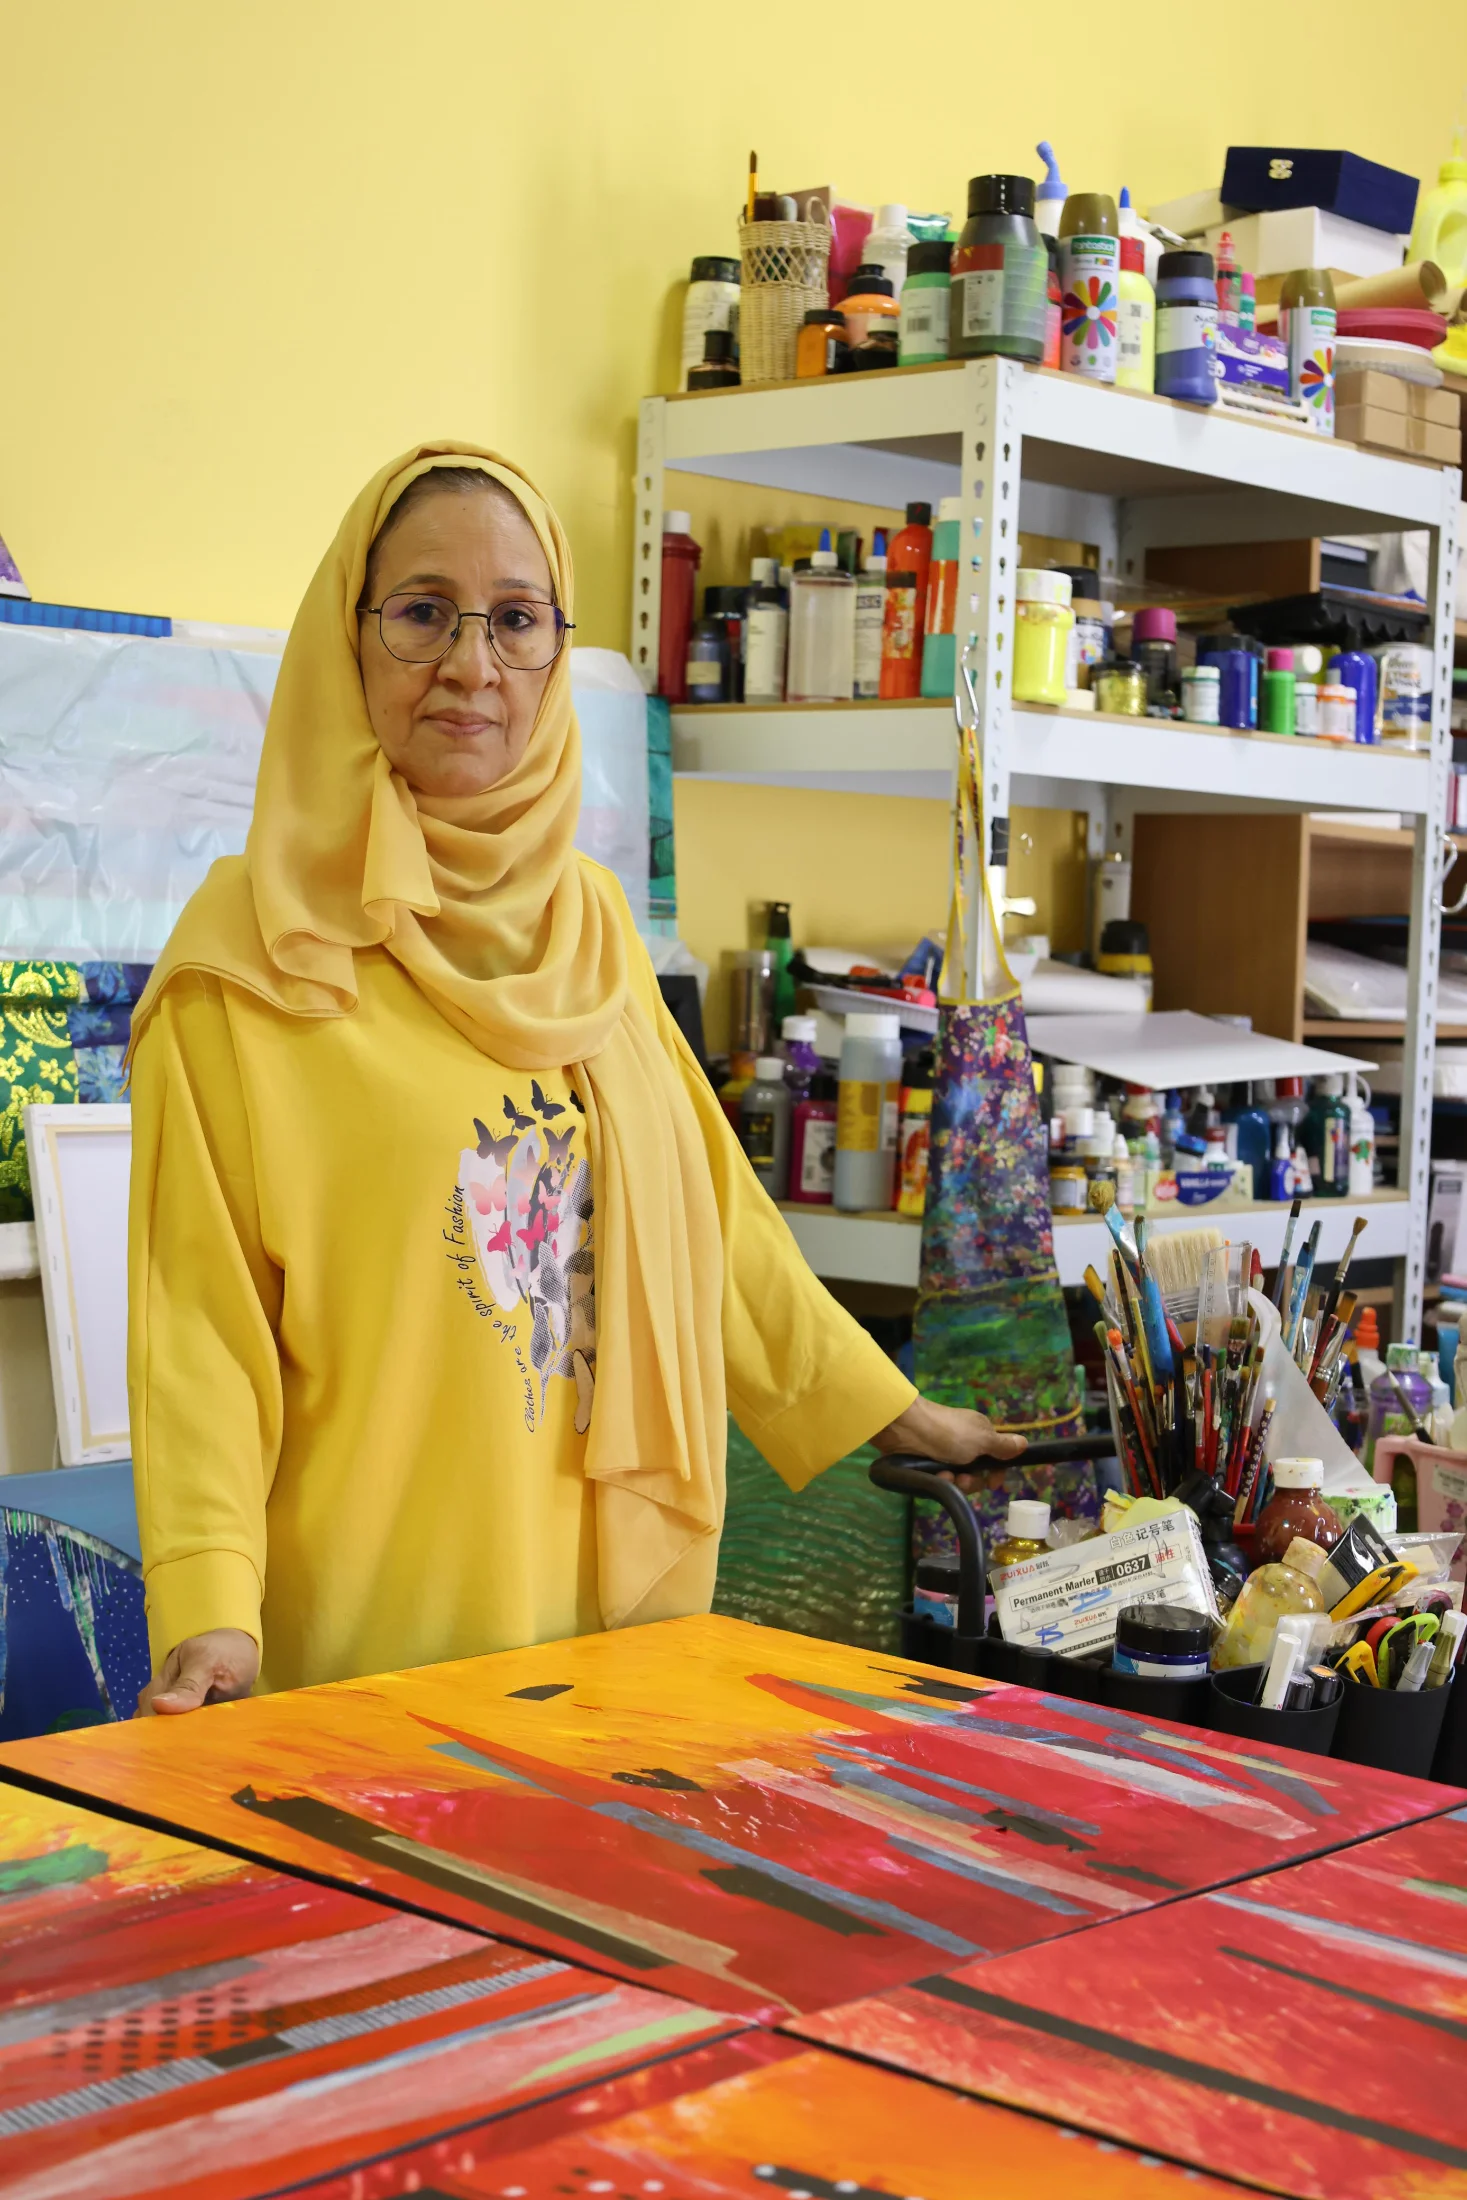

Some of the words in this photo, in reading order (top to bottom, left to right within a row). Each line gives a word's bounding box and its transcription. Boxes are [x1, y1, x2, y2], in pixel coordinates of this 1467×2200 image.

[442, 1185, 465, 1245] Fashion
[446, 1253, 476, 1270] of
[456, 1278, 496, 1317] spirit
[492, 1320, 517, 1343] the
[514, 1346, 527, 1373] are
[1110, 1519, 1175, 1549] 白色记号笔
[1116, 1556, 1147, 1577] 0637
[1013, 1586, 1063, 1608] Permanent
